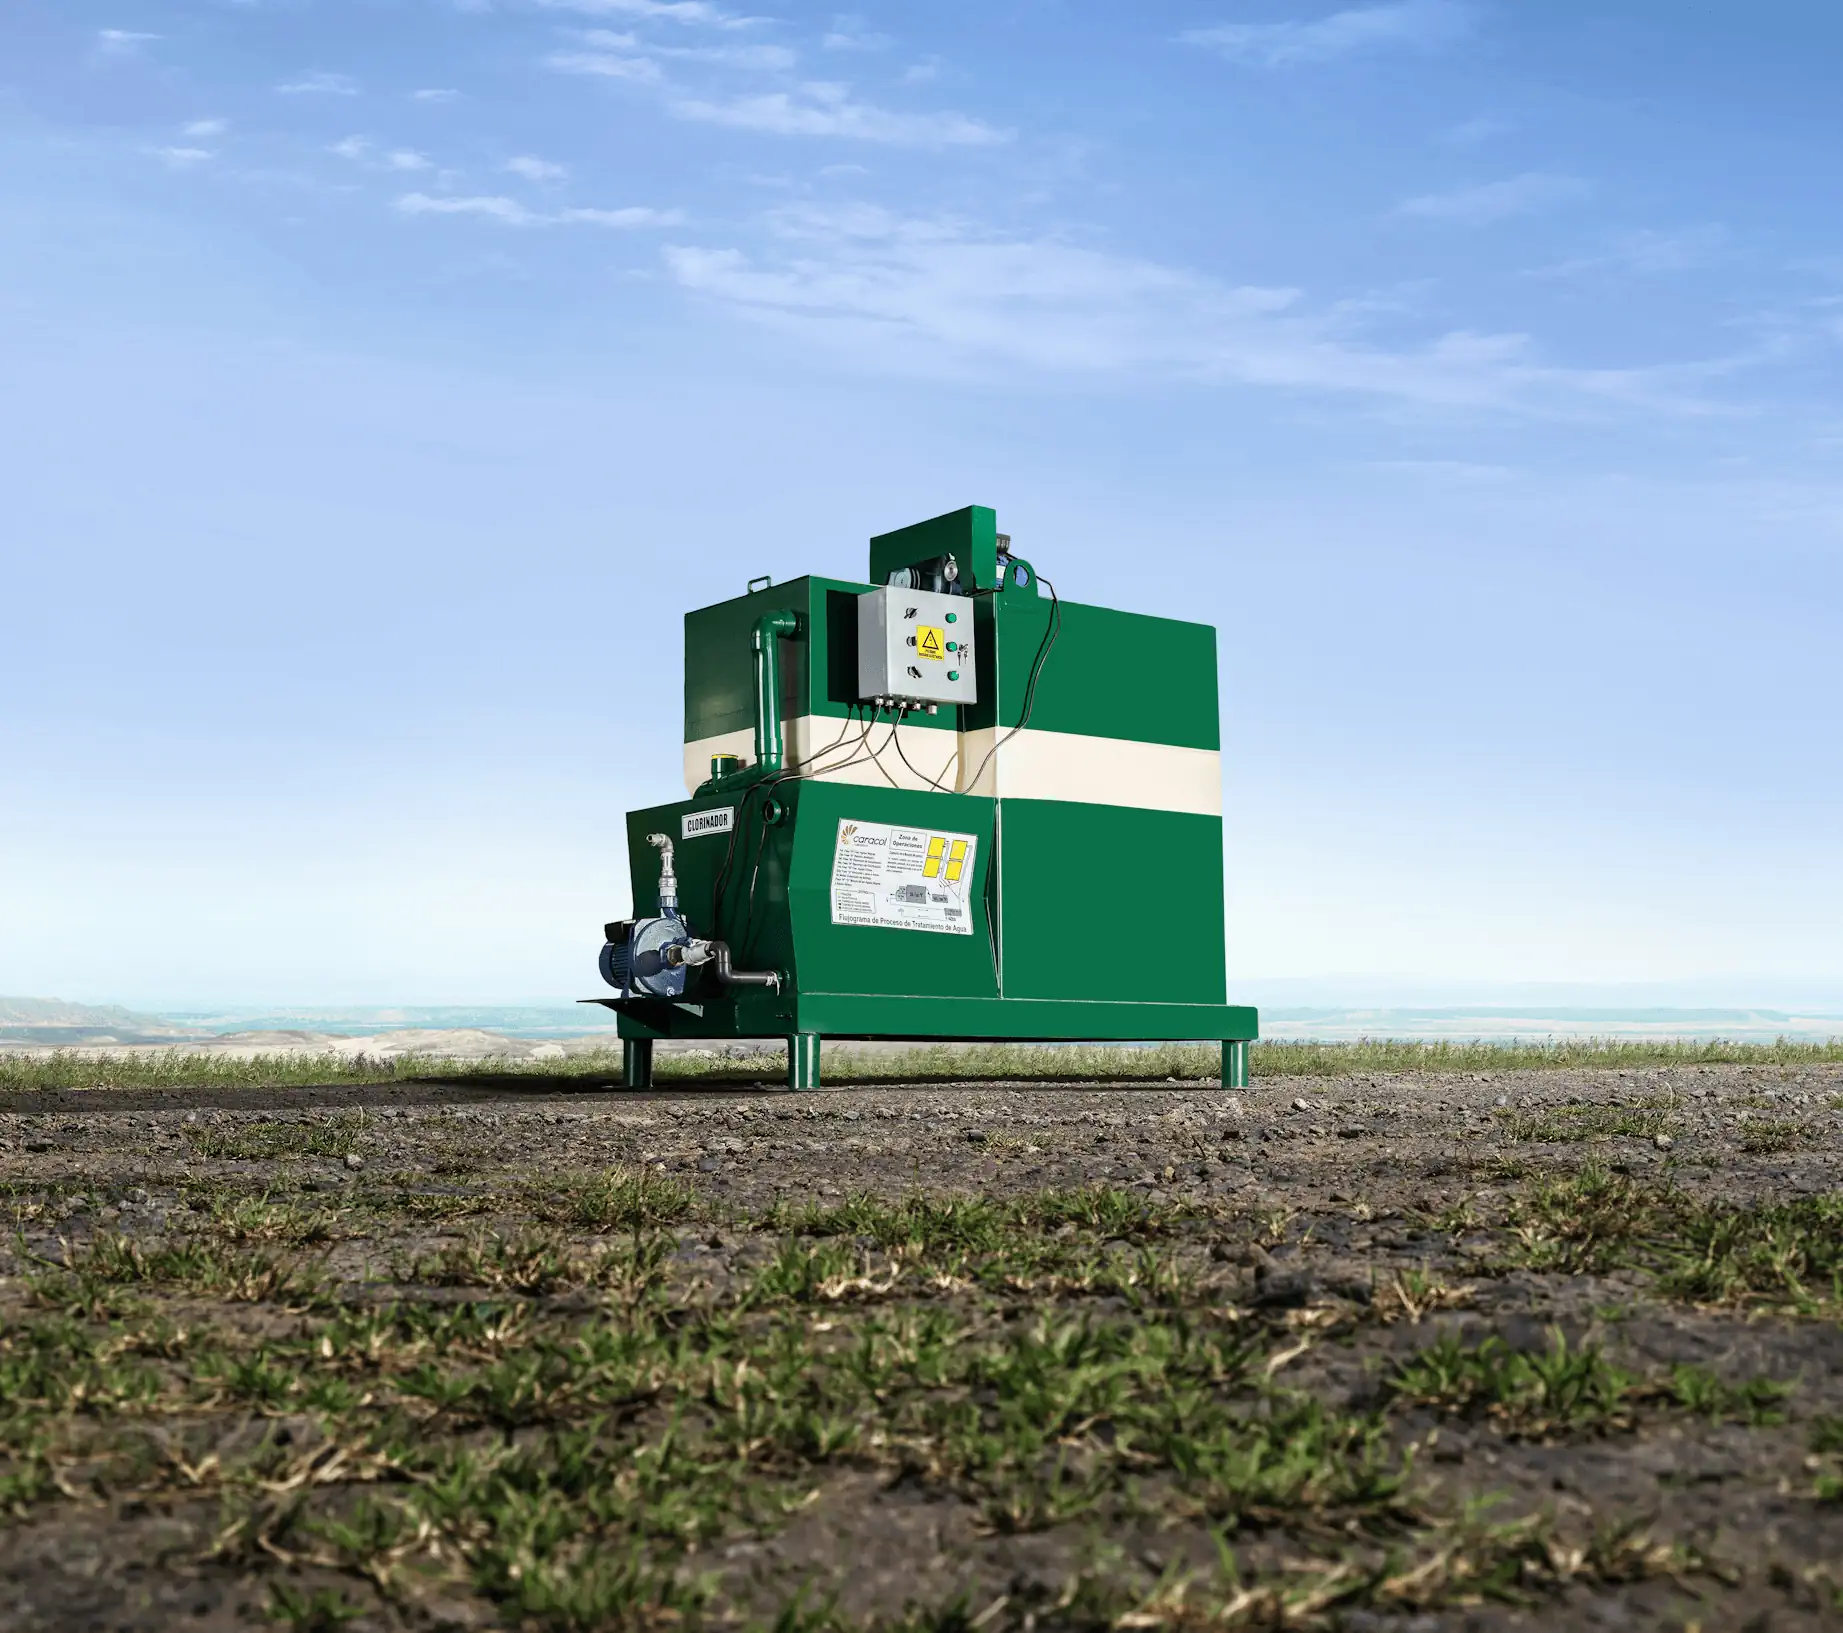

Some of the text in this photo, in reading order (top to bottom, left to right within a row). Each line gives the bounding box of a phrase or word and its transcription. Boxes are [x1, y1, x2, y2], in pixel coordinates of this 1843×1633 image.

[688, 813, 728, 832] CLORINADOR
[853, 835, 888, 846] caracol
[893, 840, 923, 849] Operaciones
[839, 913, 871, 924] Flujograma
[872, 916, 879, 924] de
[880, 917, 903, 926] Proceso
[904, 919, 911, 927] de
[912, 920, 944, 930] Tratamiento
[953, 924, 967, 934] Agua
